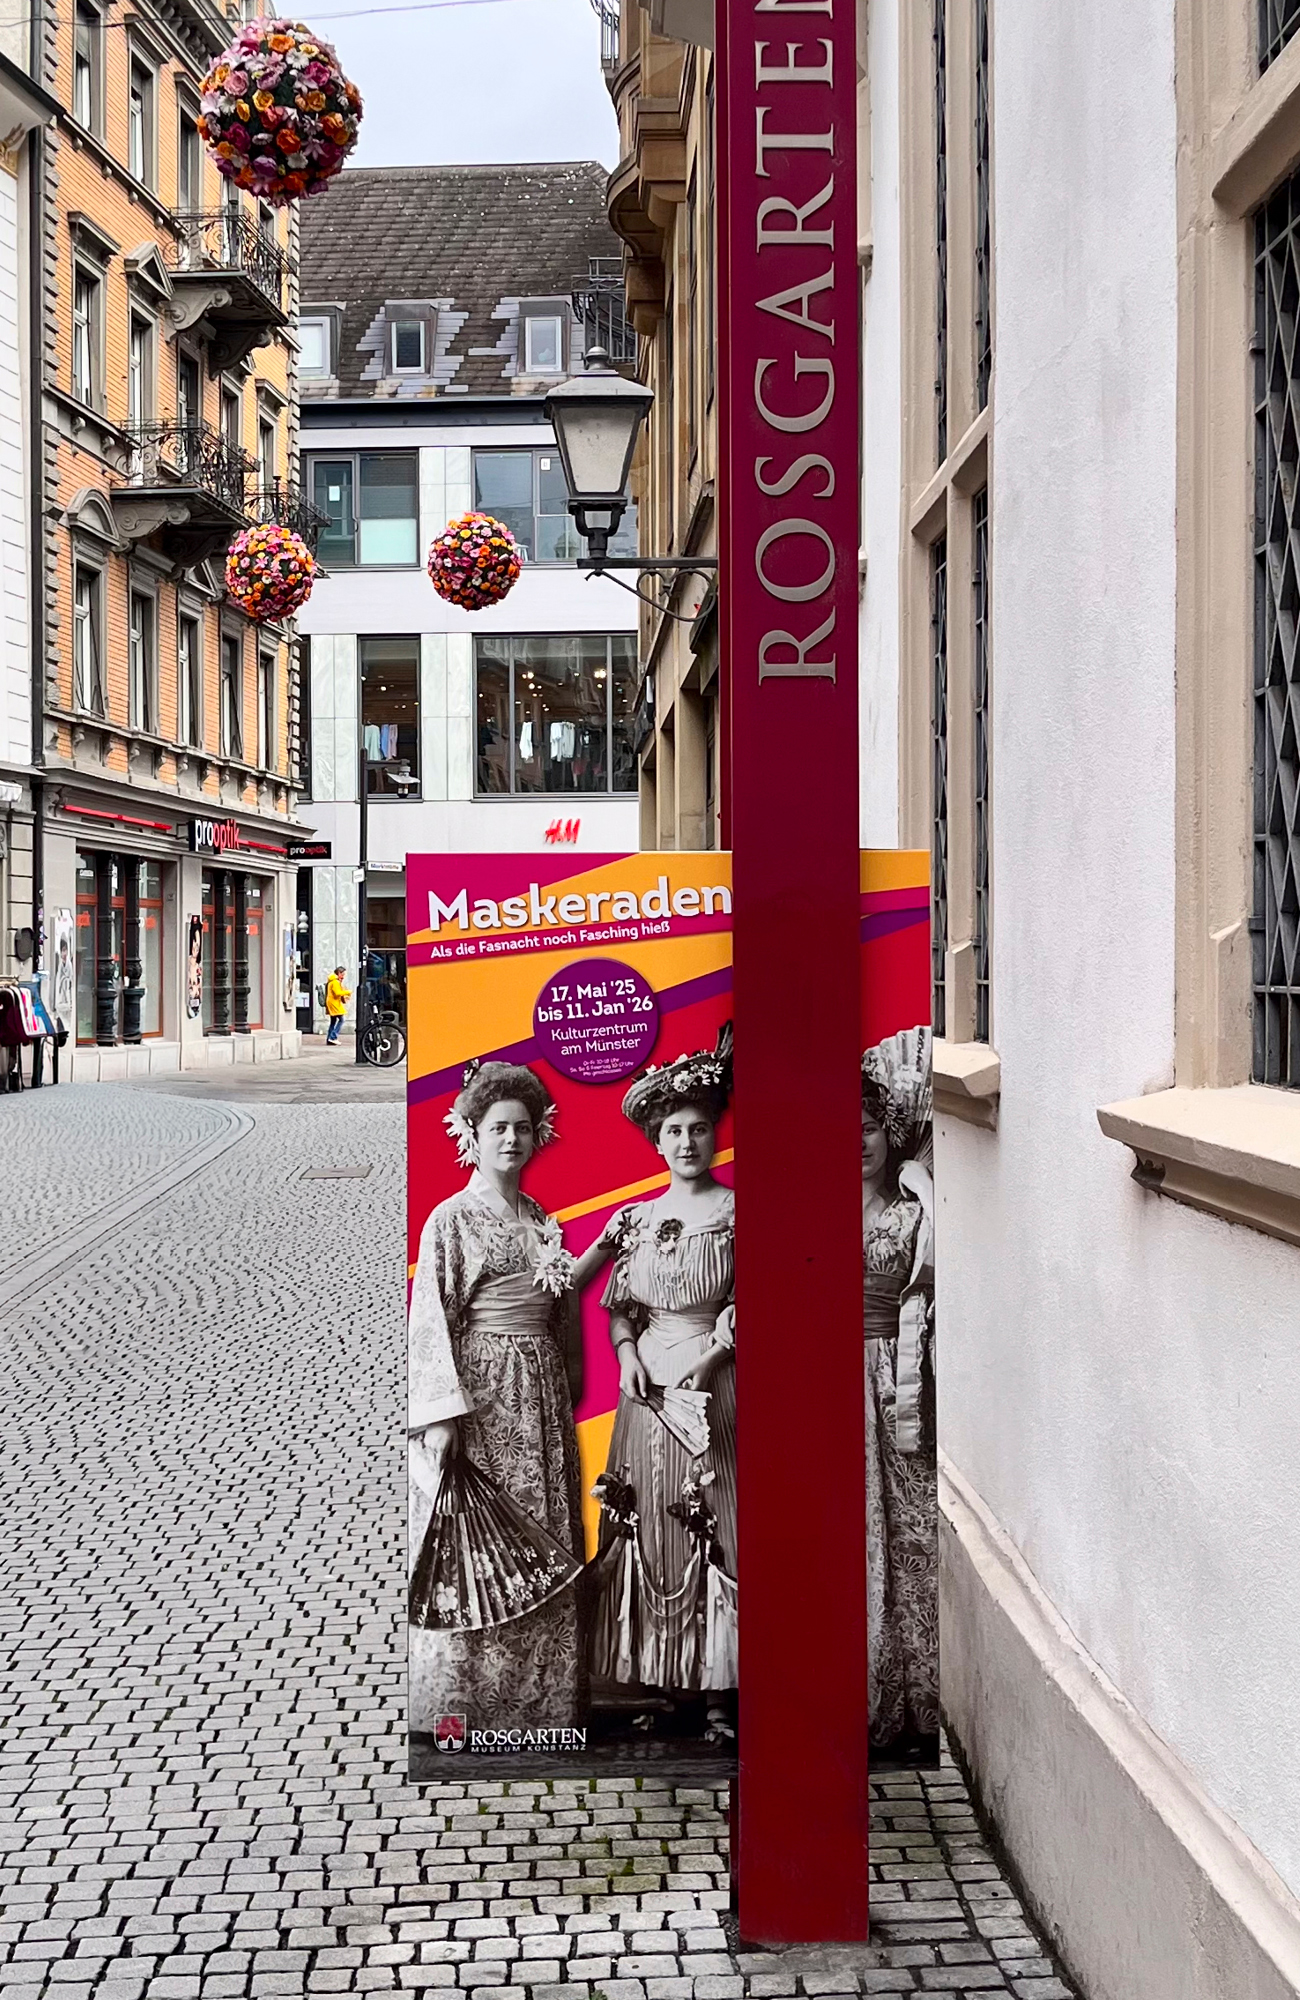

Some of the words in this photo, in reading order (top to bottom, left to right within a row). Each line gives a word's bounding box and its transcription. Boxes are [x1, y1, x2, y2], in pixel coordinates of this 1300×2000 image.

[755, 0, 836, 686] ROSGARTE
[194, 818, 240, 855] prooptik
[289, 845, 328, 856] prooptik
[428, 876, 732, 931] Maskeraden
[430, 946, 453, 959] Als
[455, 942, 476, 955] die
[479, 934, 541, 953] Fasnacht
[543, 930, 576, 946] noch
[579, 923, 640, 942] Fasching
[640, 921, 671, 935] hieß
[551, 986, 573, 1002] 17.
[576, 982, 607, 999] Mai
[610, 979, 636, 996] '25
[537, 1006, 564, 1022] bis
[565, 1003, 590, 1019] 11.
[592, 1000, 625, 1017] Jan
[626, 995, 654, 1013] '26
[551, 1023, 648, 1041] Kulturzentrum
[560, 1046, 582, 1056] am
[585, 1038, 641, 1053] Münster
[471, 1728, 587, 1746] ROSGARTEN
[527, 1744, 586, 1752] KONSTANZ
